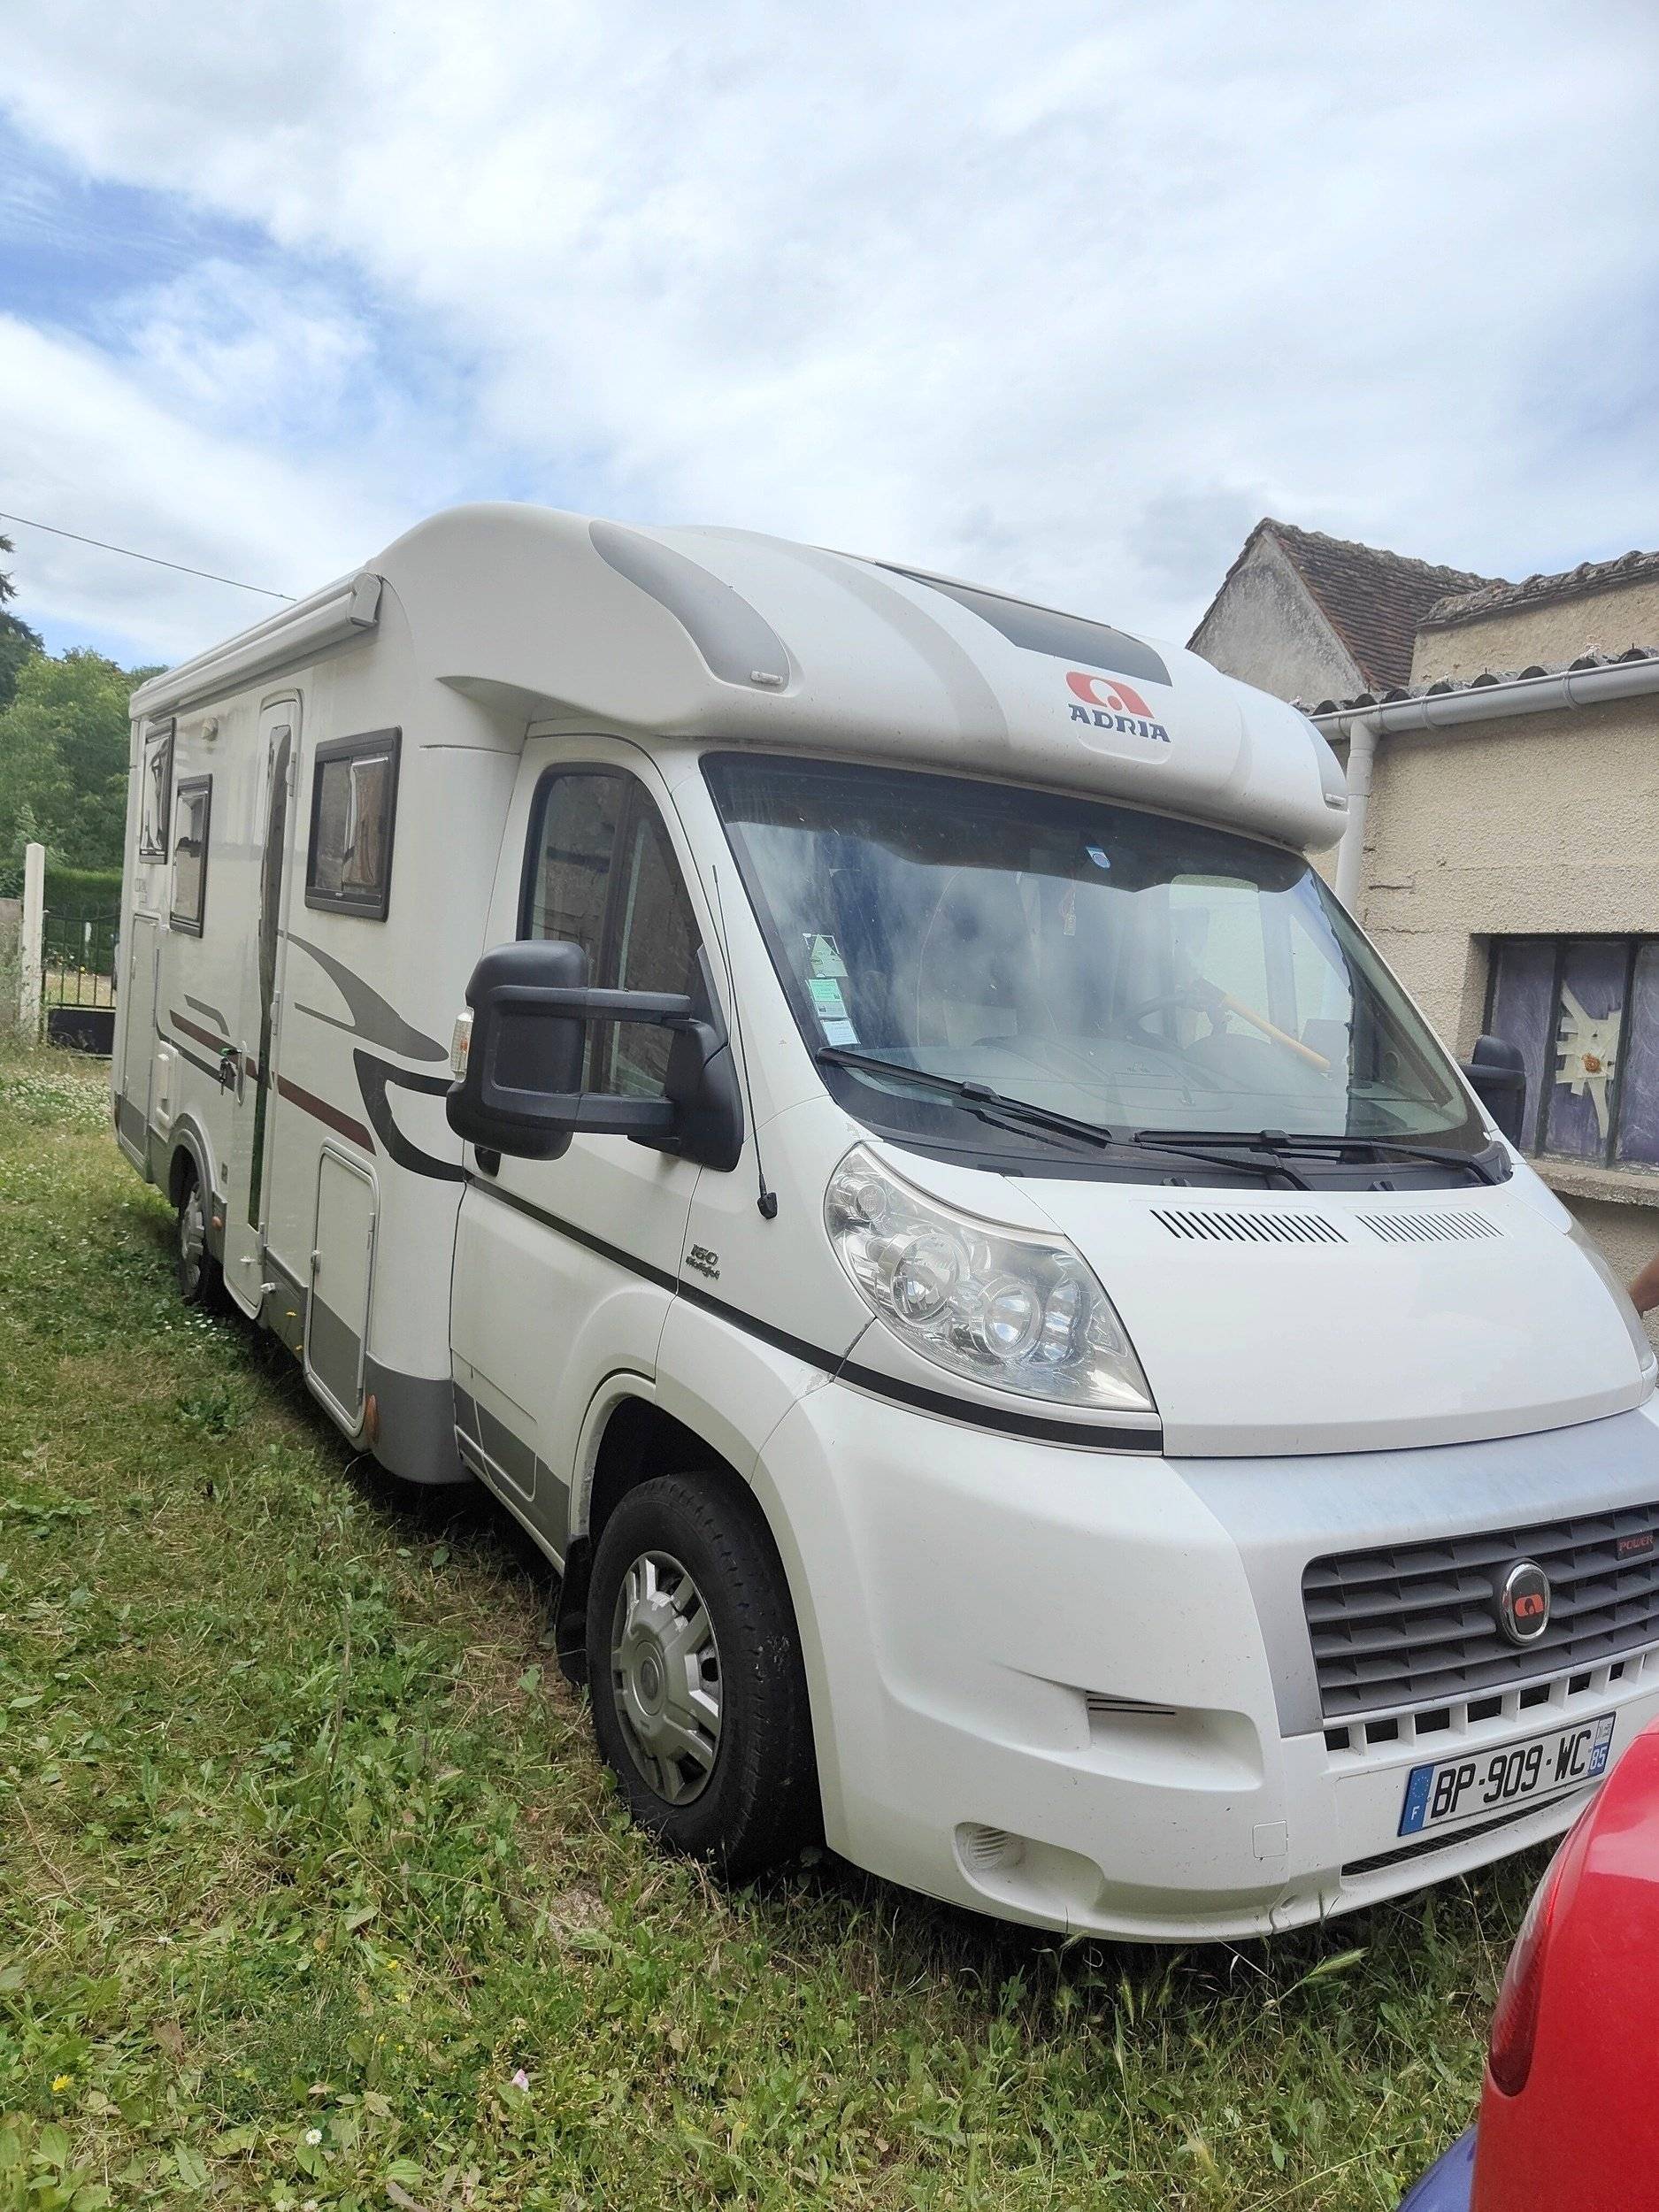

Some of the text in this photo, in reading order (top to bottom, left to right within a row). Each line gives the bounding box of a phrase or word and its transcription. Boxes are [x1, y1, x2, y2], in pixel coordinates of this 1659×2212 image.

[1068, 703, 1171, 743] ADRIA
[1589, 1746, 1608, 1770] 85
[1410, 1805, 1420, 1821] F
